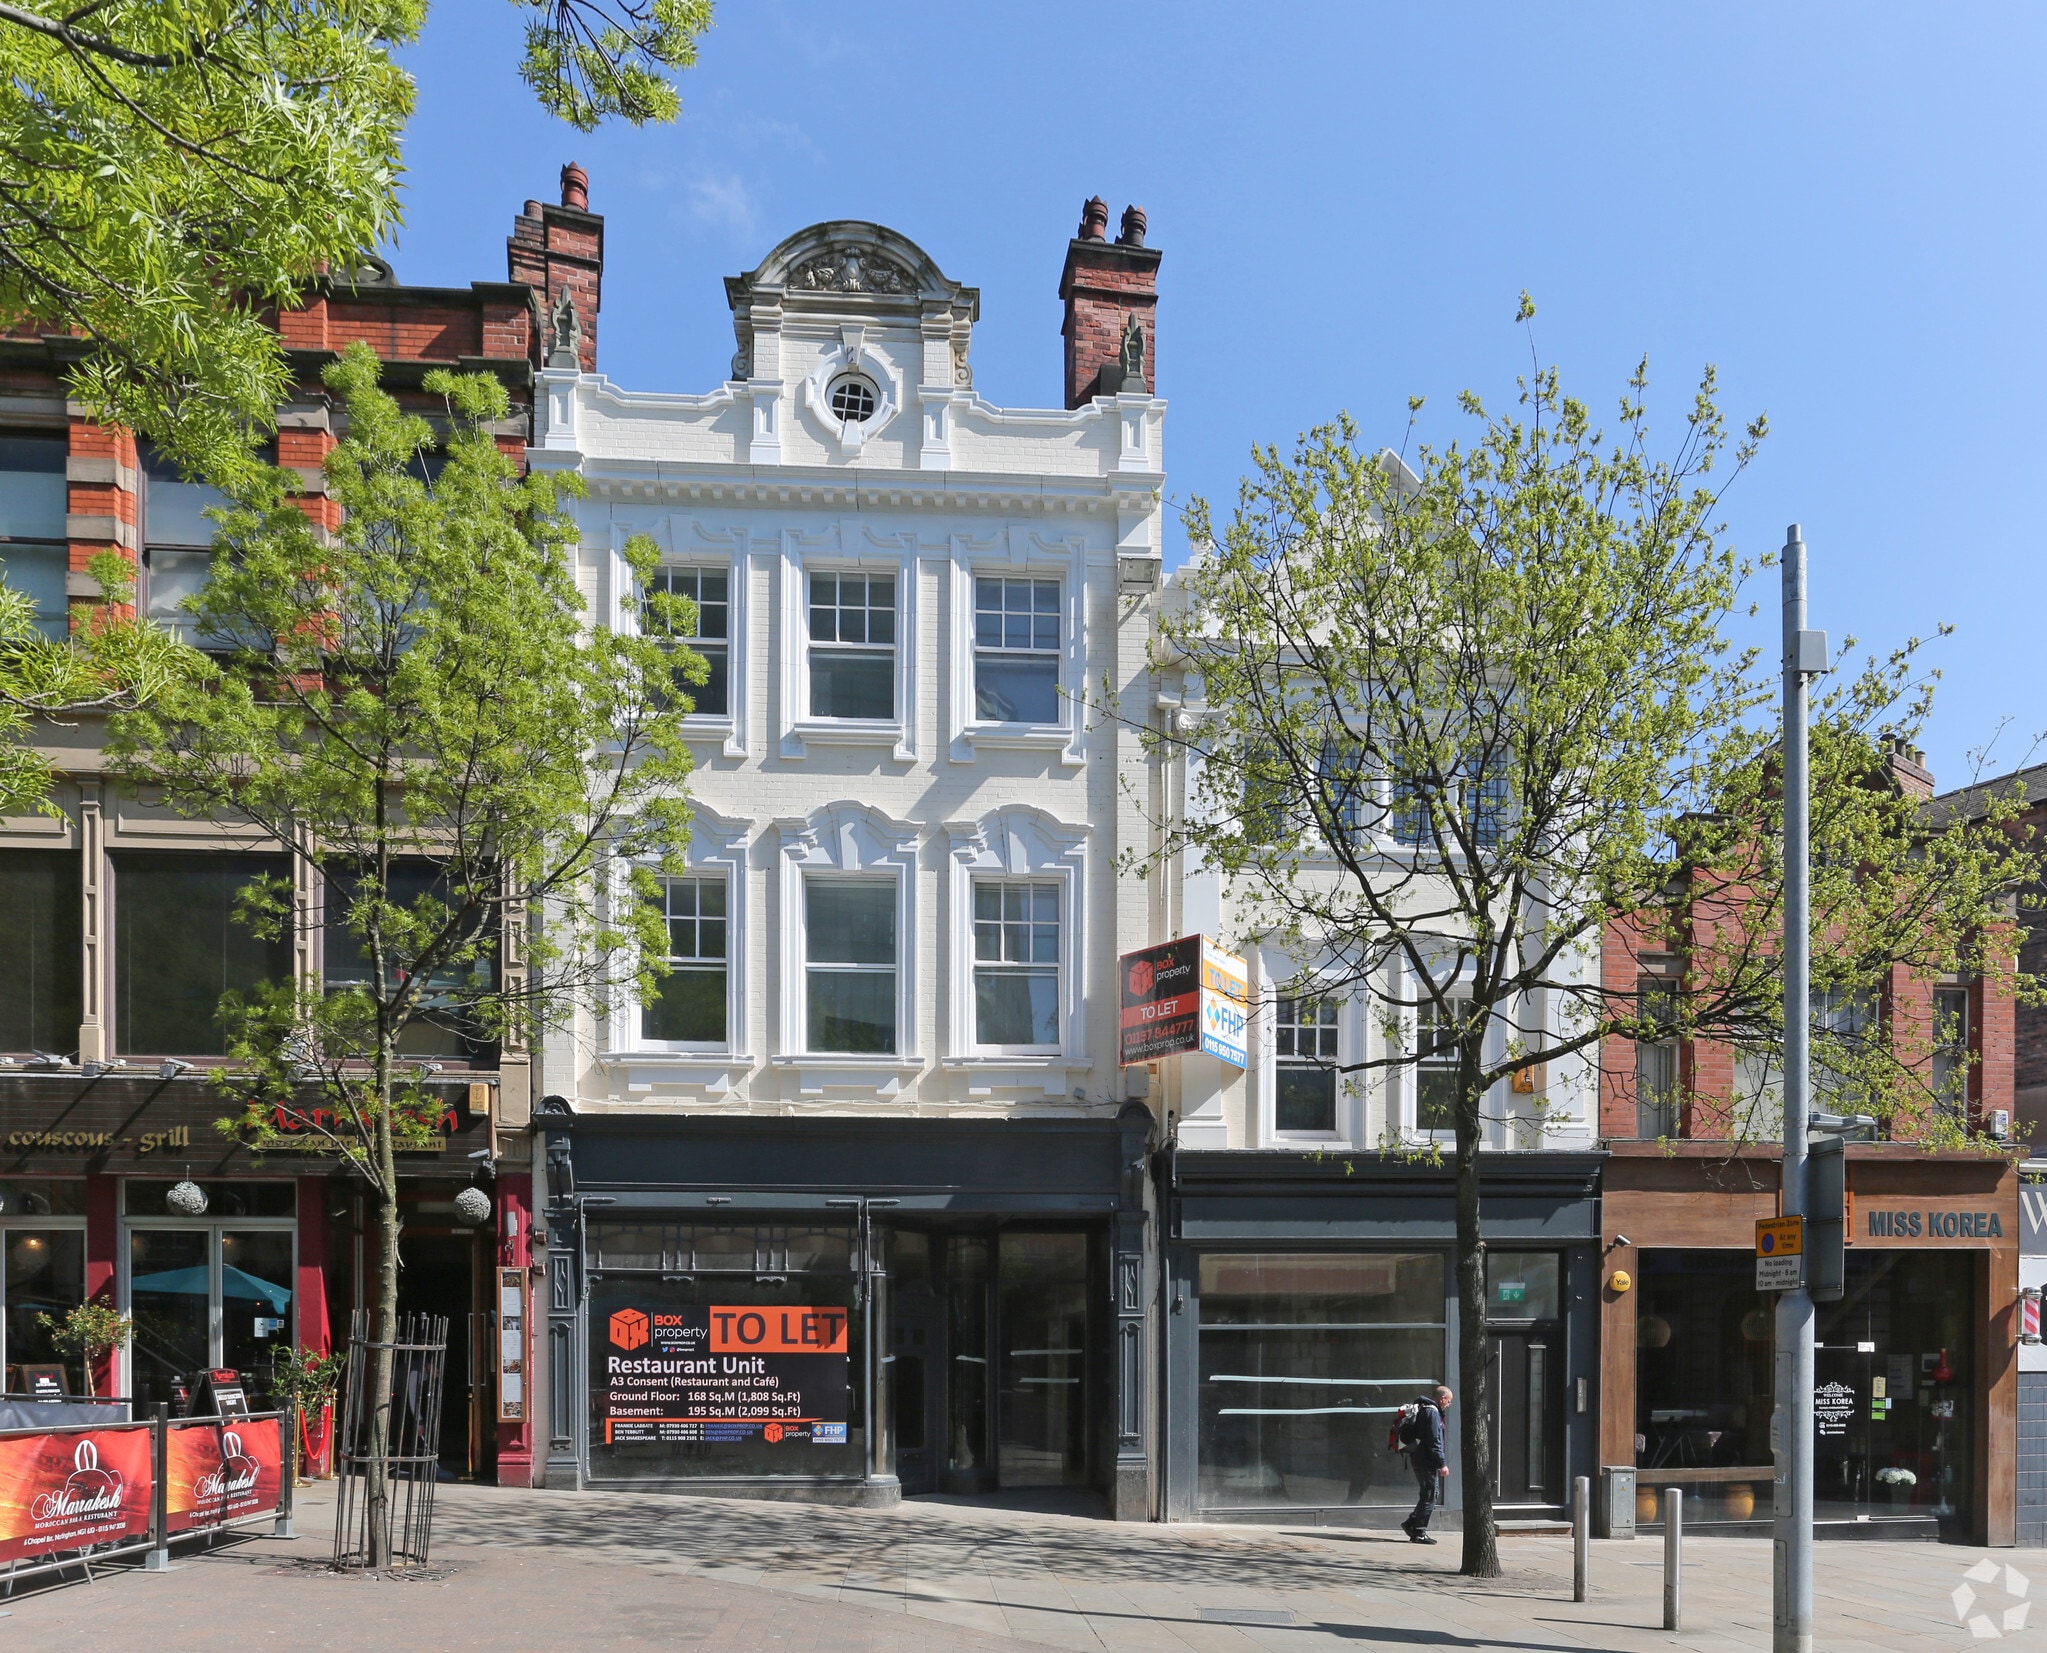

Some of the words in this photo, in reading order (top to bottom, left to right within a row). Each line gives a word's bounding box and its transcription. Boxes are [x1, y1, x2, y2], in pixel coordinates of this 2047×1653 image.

[1157, 957, 1175, 970] BOX
[1156, 964, 1191, 982] property
[1209, 967, 1222, 989] TO
[1140, 1007, 1155, 1020] TO
[1157, 1000, 1178, 1016] LET
[1221, 1006, 1243, 1038] FHP
[1125, 1033, 1194, 1056] www.boxprop.co.uk
[1204, 1037, 1218, 1052] 0115
[1218, 1042, 1230, 1057] 950
[1230, 1047, 1245, 1064] 7577
[9, 1130, 115, 1146] couscous
[139, 1125, 190, 1152] grill
[1758, 1222, 1785, 1230] Pedestrian
[1869, 1211, 1921, 1238] MISS
[1929, 1211, 2002, 1238] KOREA
[1773, 1259, 1793, 1267] loading
[1759, 1269, 1781, 1278] Midnight
[1615, 1278, 1629, 1286] Yale
[1776, 1278, 1798, 1287] midnight
[654, 1315, 682, 1326] BOX
[654, 1326, 708, 1340] property
[713, 1312, 765, 1344] TO
[781, 1313, 845, 1345] LET
[608, 1356, 716, 1374] Restaurant
[722, 1356, 765, 1374] Unit
[610, 1377, 624, 1386] A3
[626, 1377, 668, 1387] Consent
[670, 1376, 729, 1388] (Restaurant
[731, 1377, 750, 1387] and
[752, 1376, 779, 1388] Café)
[610, 1391, 650, 1401] Ground
[651, 1391, 680, 1401] Floor:
[688, 1392, 706, 1401] 168
[709, 1391, 735, 1404] Sq.M
[738, 1391, 769, 1403] (1,808
[771, 1391, 801, 1404] Sq.Ft)
[1815, 1397, 1831, 1405] MISS
[1832, 1397, 1854, 1405] KOREA
[610, 1406, 664, 1416] Basement:
[688, 1406, 706, 1416] 195
[709, 1406, 735, 1418] Sq.M
[738, 1406, 769, 1418] (2,099
[771, 1406, 801, 1418] Sq.Ft)
[785, 1430, 811, 1438] property
[824, 1426, 844, 1435] FHP
[31, 1477, 123, 1521] Marrakesh
[34, 1518, 69, 1530] MOROCCAN
[28, 1535, 46, 1546] Chapel
